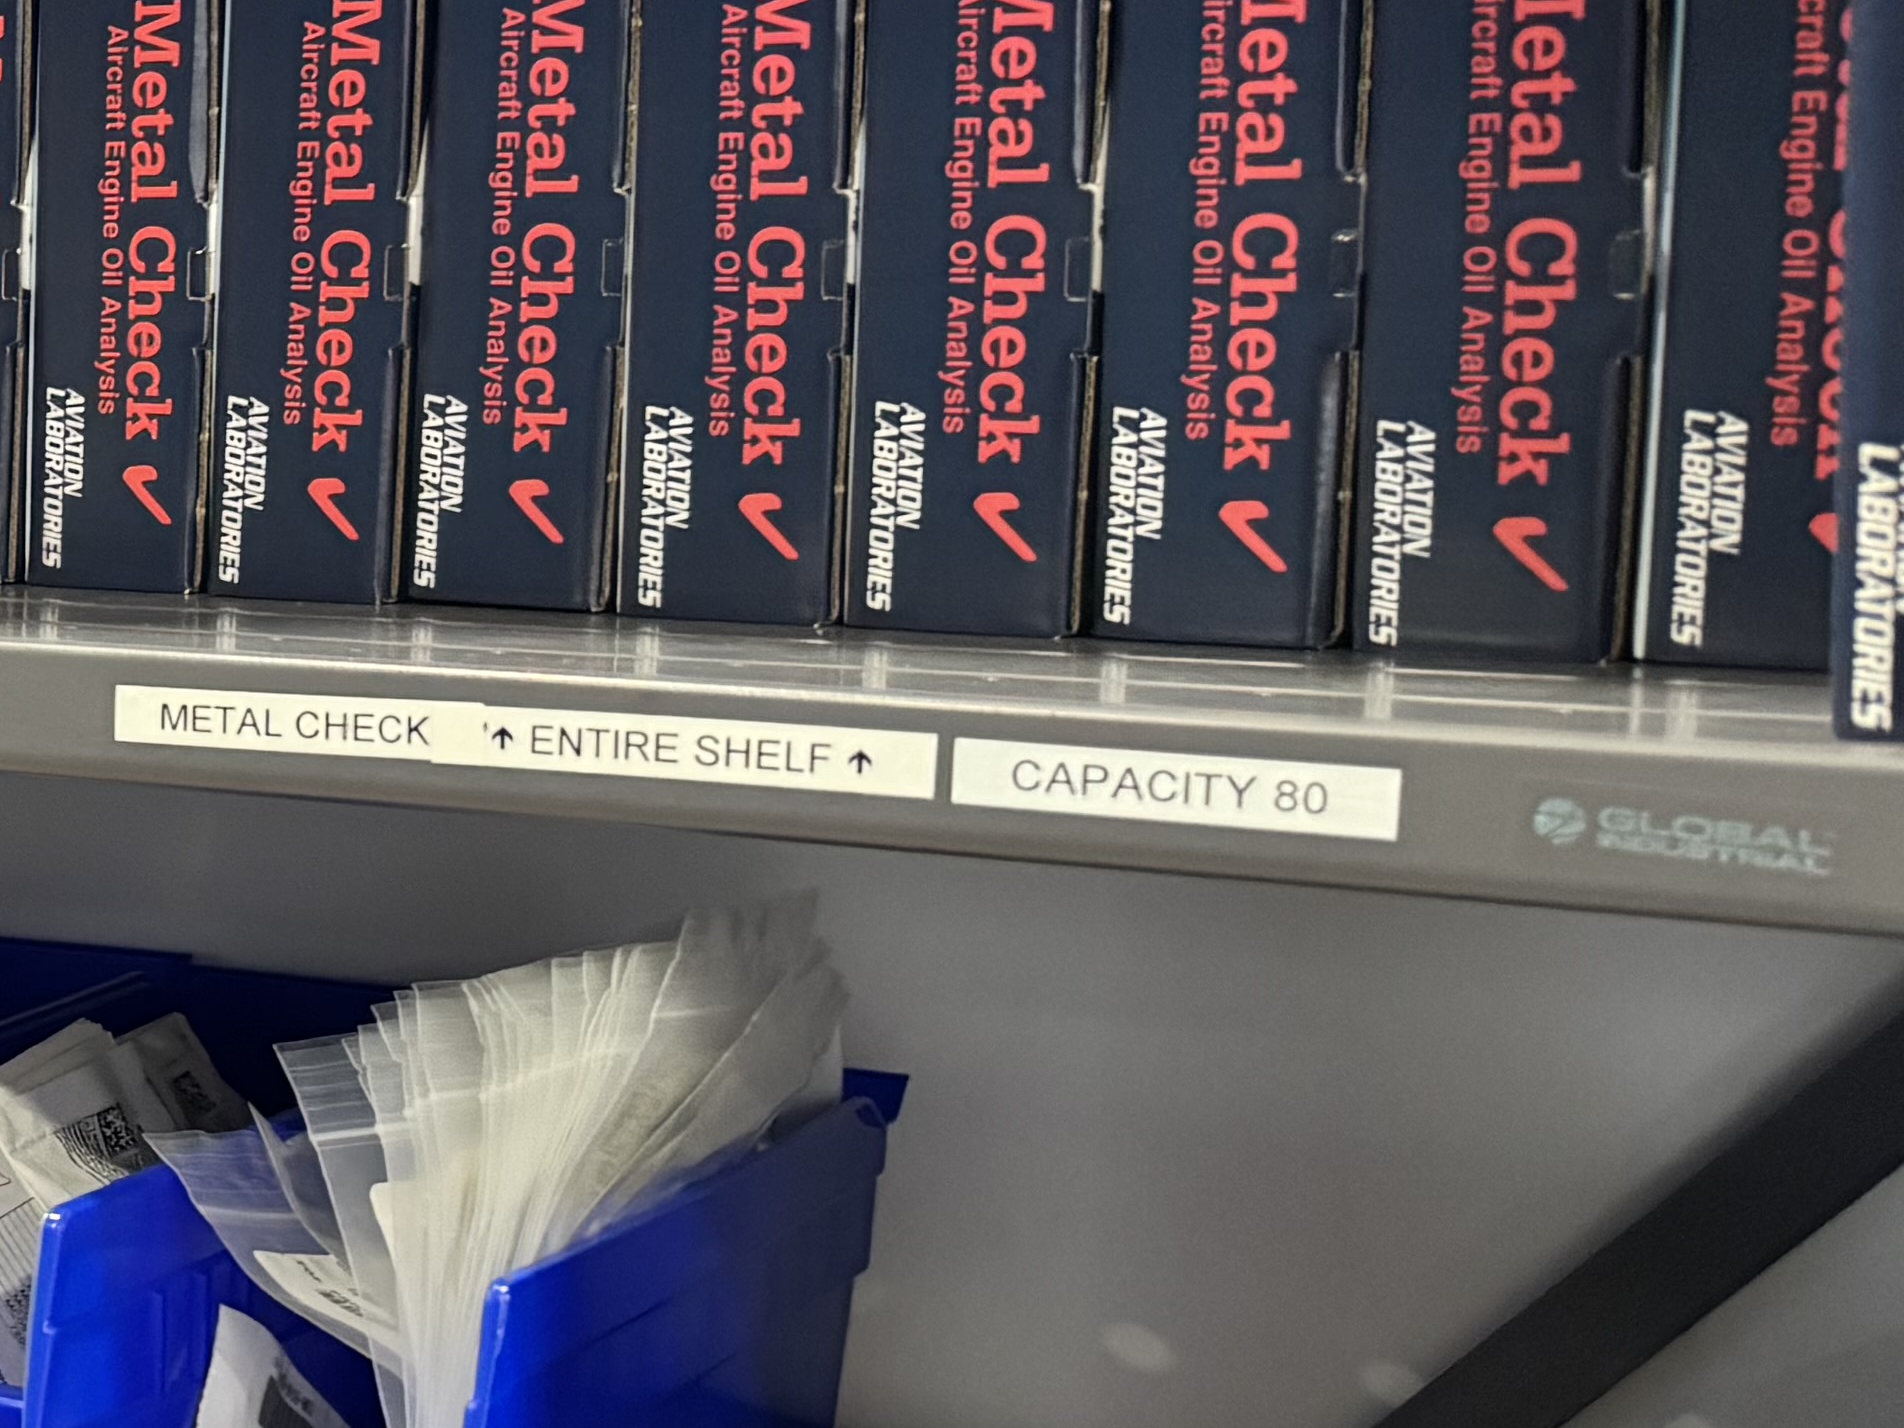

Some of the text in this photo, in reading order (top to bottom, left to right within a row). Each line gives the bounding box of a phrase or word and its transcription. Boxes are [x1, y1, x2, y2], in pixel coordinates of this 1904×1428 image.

[946, 118, 983, 229] Engine
[950, 242, 978, 284] Oil
[940, 298, 975, 432] Analysis
[979, 216, 1046, 463] Check
[866, 400, 900, 612] LABORATORIES
[896, 402, 926, 529] AVIATION
[159, 703, 431, 747] METAL CHECK
[530, 725, 833, 774] ENTIRE SHELF
[1010, 757, 1330, 814] CAPACITY 80
[1596, 806, 1832, 856] GLOBAL
